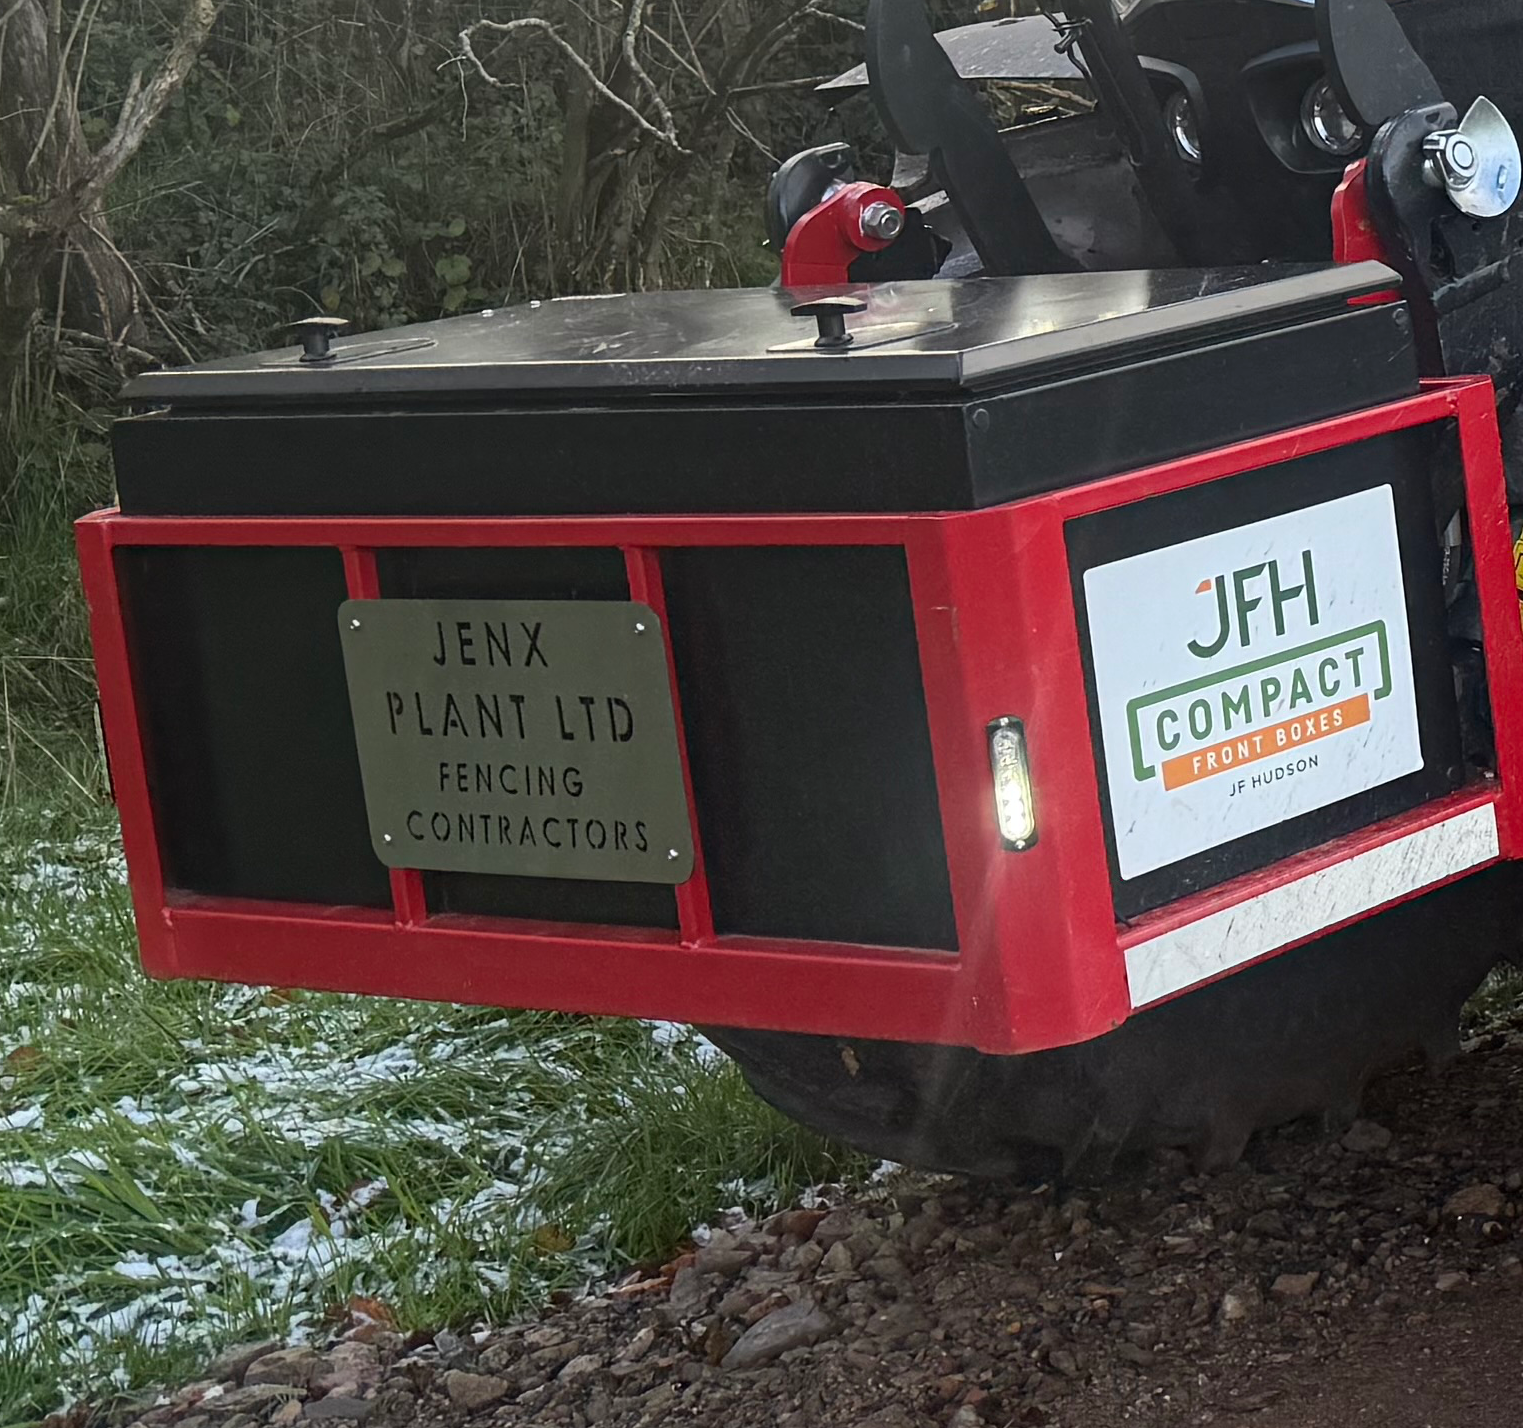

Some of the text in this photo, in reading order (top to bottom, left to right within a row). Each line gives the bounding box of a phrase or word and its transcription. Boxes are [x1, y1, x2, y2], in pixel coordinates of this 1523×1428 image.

[1187, 549, 1319, 659] JFH
[433, 621, 548, 668] JENX
[386, 690, 635, 743] PLANT LTD
[1157, 646, 1366, 752] COMPACT
[1193, 708, 1344, 775] FRONT BOXES
[439, 762, 584, 798] FENCING
[1229, 754, 1319, 798] JF HUDSON
[406, 809, 648, 853] CONTRACTORS
